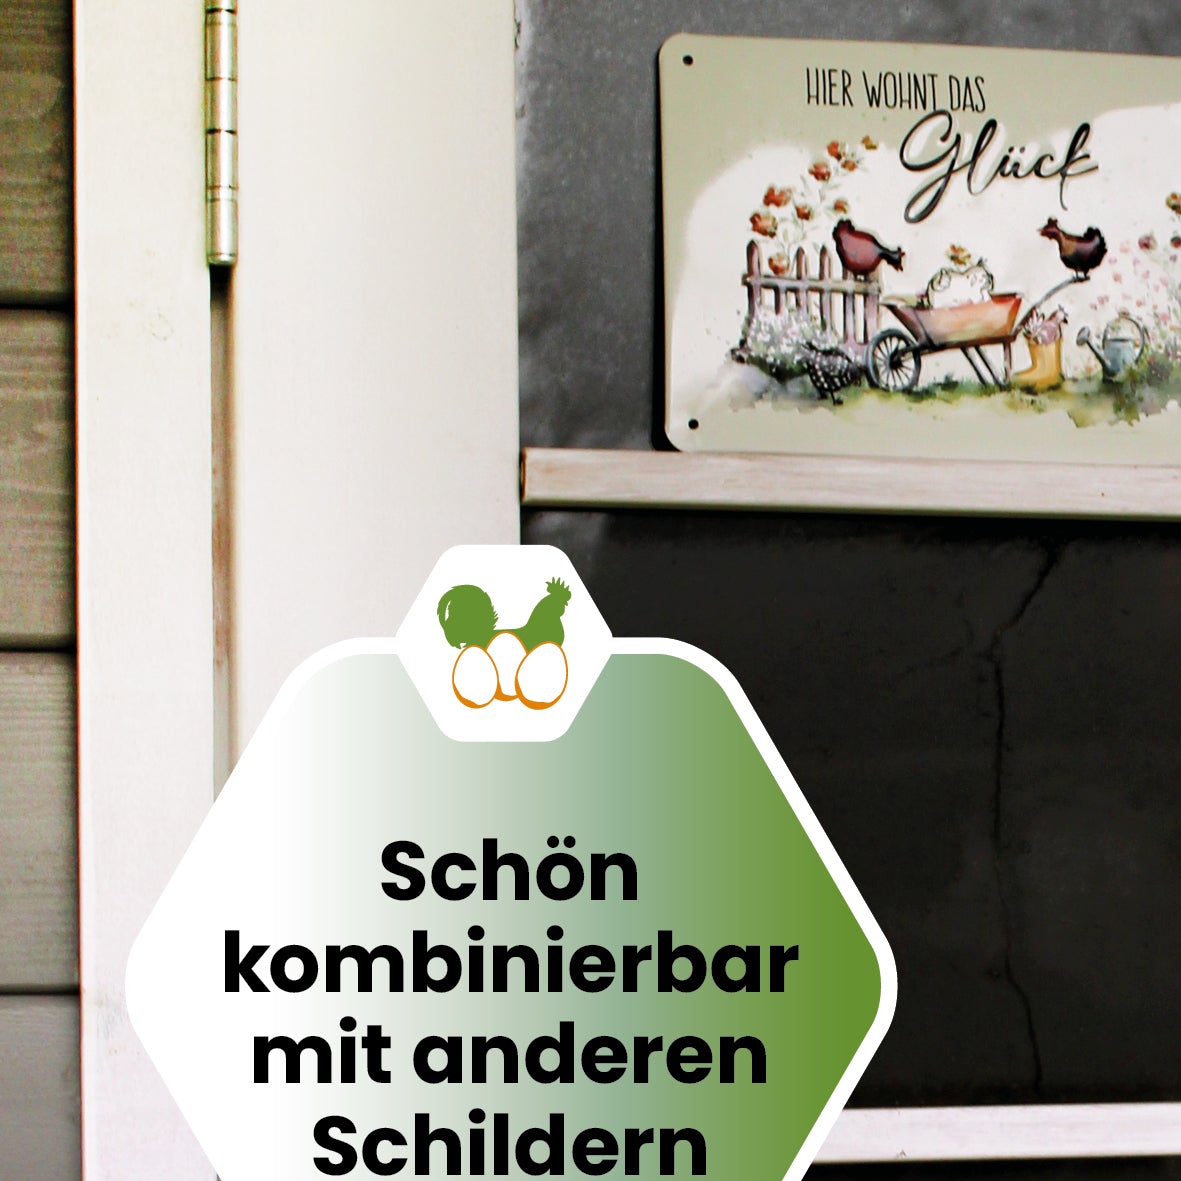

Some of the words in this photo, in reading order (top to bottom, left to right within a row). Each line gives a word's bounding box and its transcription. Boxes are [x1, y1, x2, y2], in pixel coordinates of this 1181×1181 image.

[805, 67, 853, 107] HIER
[862, 71, 938, 112] WOHNT
[948, 75, 986, 113] DAS
[899, 109, 1098, 223] Glück
